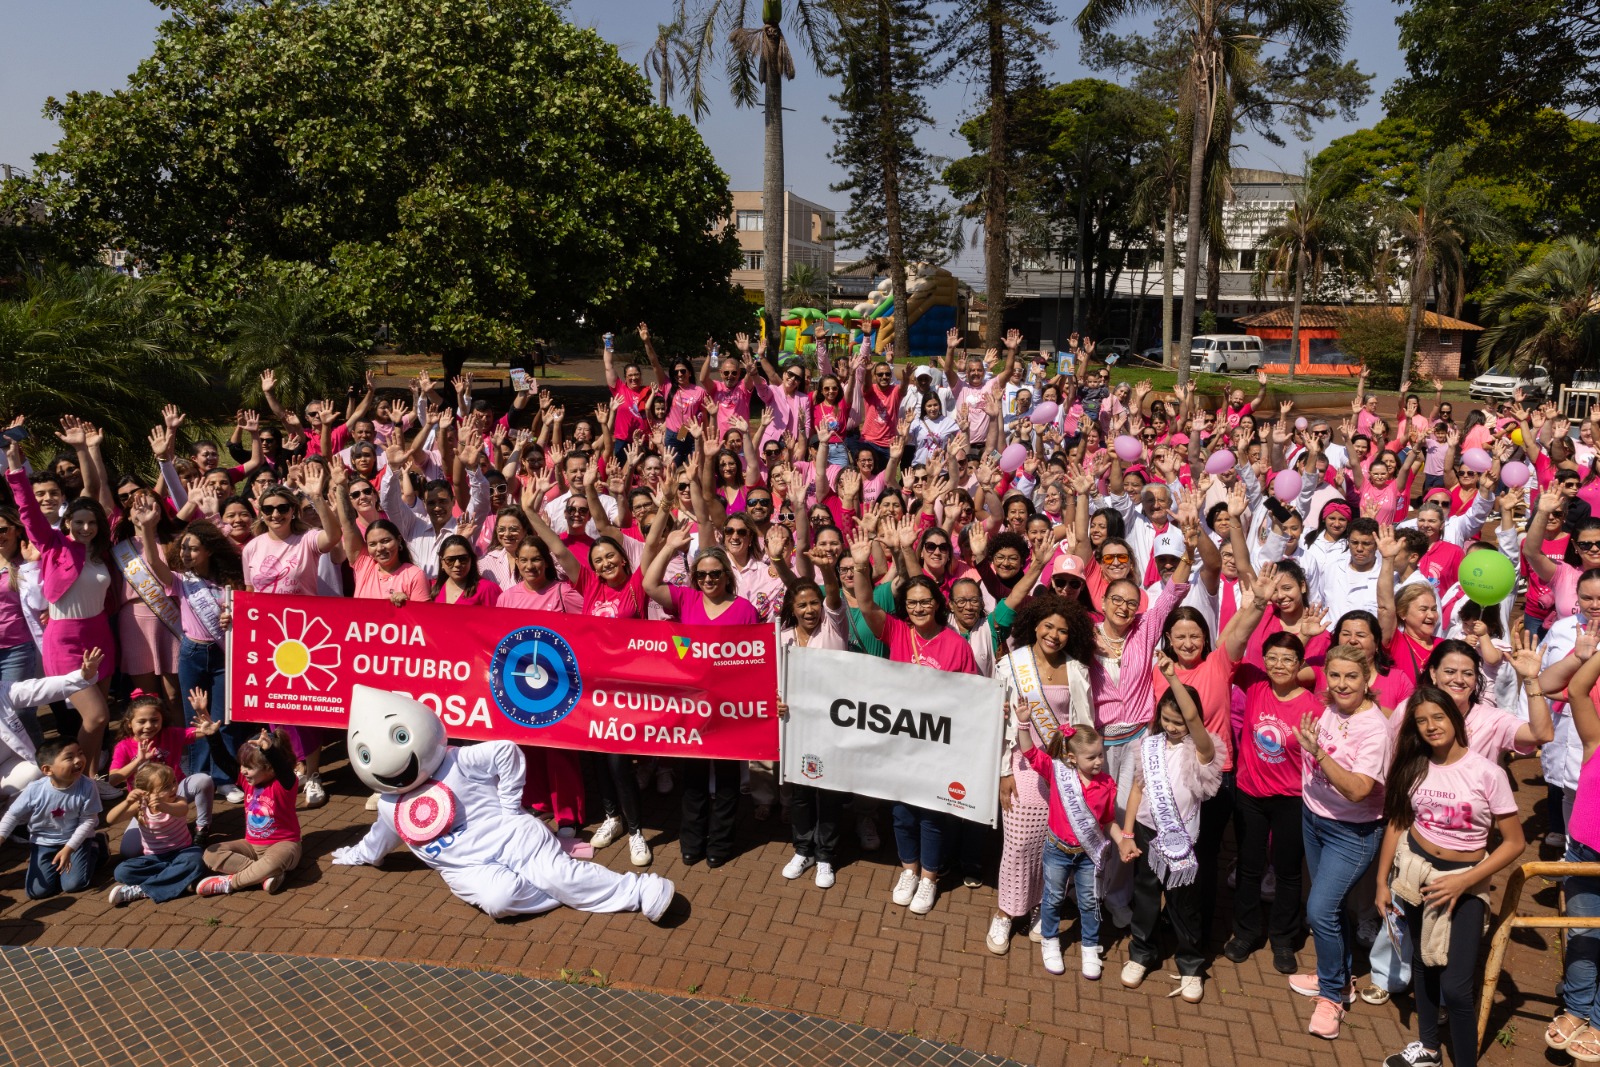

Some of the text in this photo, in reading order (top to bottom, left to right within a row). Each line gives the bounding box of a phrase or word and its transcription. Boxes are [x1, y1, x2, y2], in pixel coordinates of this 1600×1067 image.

[120, 551, 179, 625] MISS SIMPATIA
[344, 621, 427, 647] APOIA
[627, 637, 766, 659] APOIO SICOOB
[243, 608, 260, 708] CISAM
[352, 654, 472, 681] OUTUBRO
[1016, 663, 1035, 694] MISS
[267, 693, 343, 704] CENTRO INTEGRADO
[276, 702, 302, 711] SAÚDE
[314, 705, 345, 714] MULHER
[391, 690, 494, 729] OSA
[592, 689, 769, 721] O CUIDADO QUE
[588, 716, 703, 746] NÃO PARA
[829, 698, 952, 745] CISAM
[1147, 738, 1161, 778] PRINCESA
[1063, 784, 1082, 818] INFANTIL
[1415, 788, 1456, 800] UTUBRO
